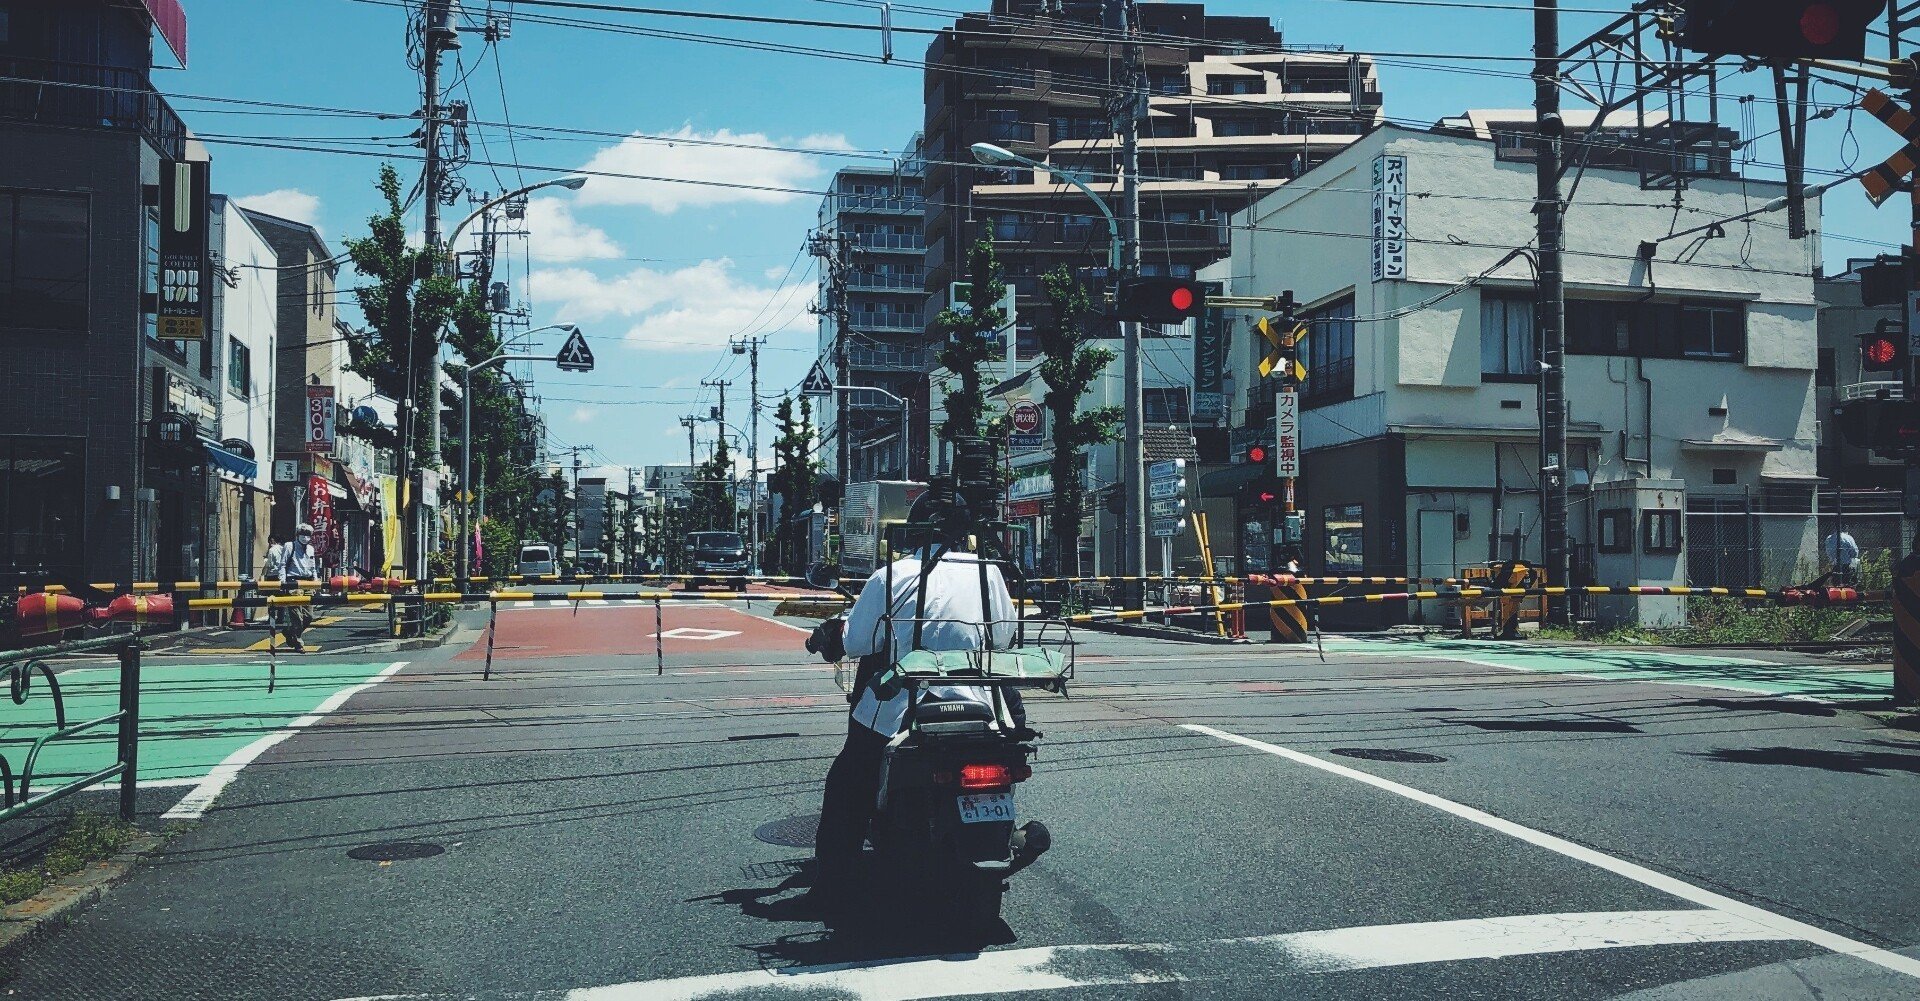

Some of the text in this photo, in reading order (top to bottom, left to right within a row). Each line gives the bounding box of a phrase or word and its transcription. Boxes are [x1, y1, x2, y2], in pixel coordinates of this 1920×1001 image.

[1387, 159, 1403, 276] アパート・マンション
[164, 260, 199, 268] COFFEE
[164, 269, 199, 286] DOU
[163, 286, 199, 303] TOR
[163, 307, 199, 315] ドトールコーヒー
[1202, 286, 1216, 388] アート・マンション
[312, 399, 324, 441] 300
[1015, 413, 1036, 423] 消火栓
[1281, 395, 1295, 475] カメラ監視中
[312, 482, 330, 531] お弁当
[939, 704, 965, 712] YAMAHA
